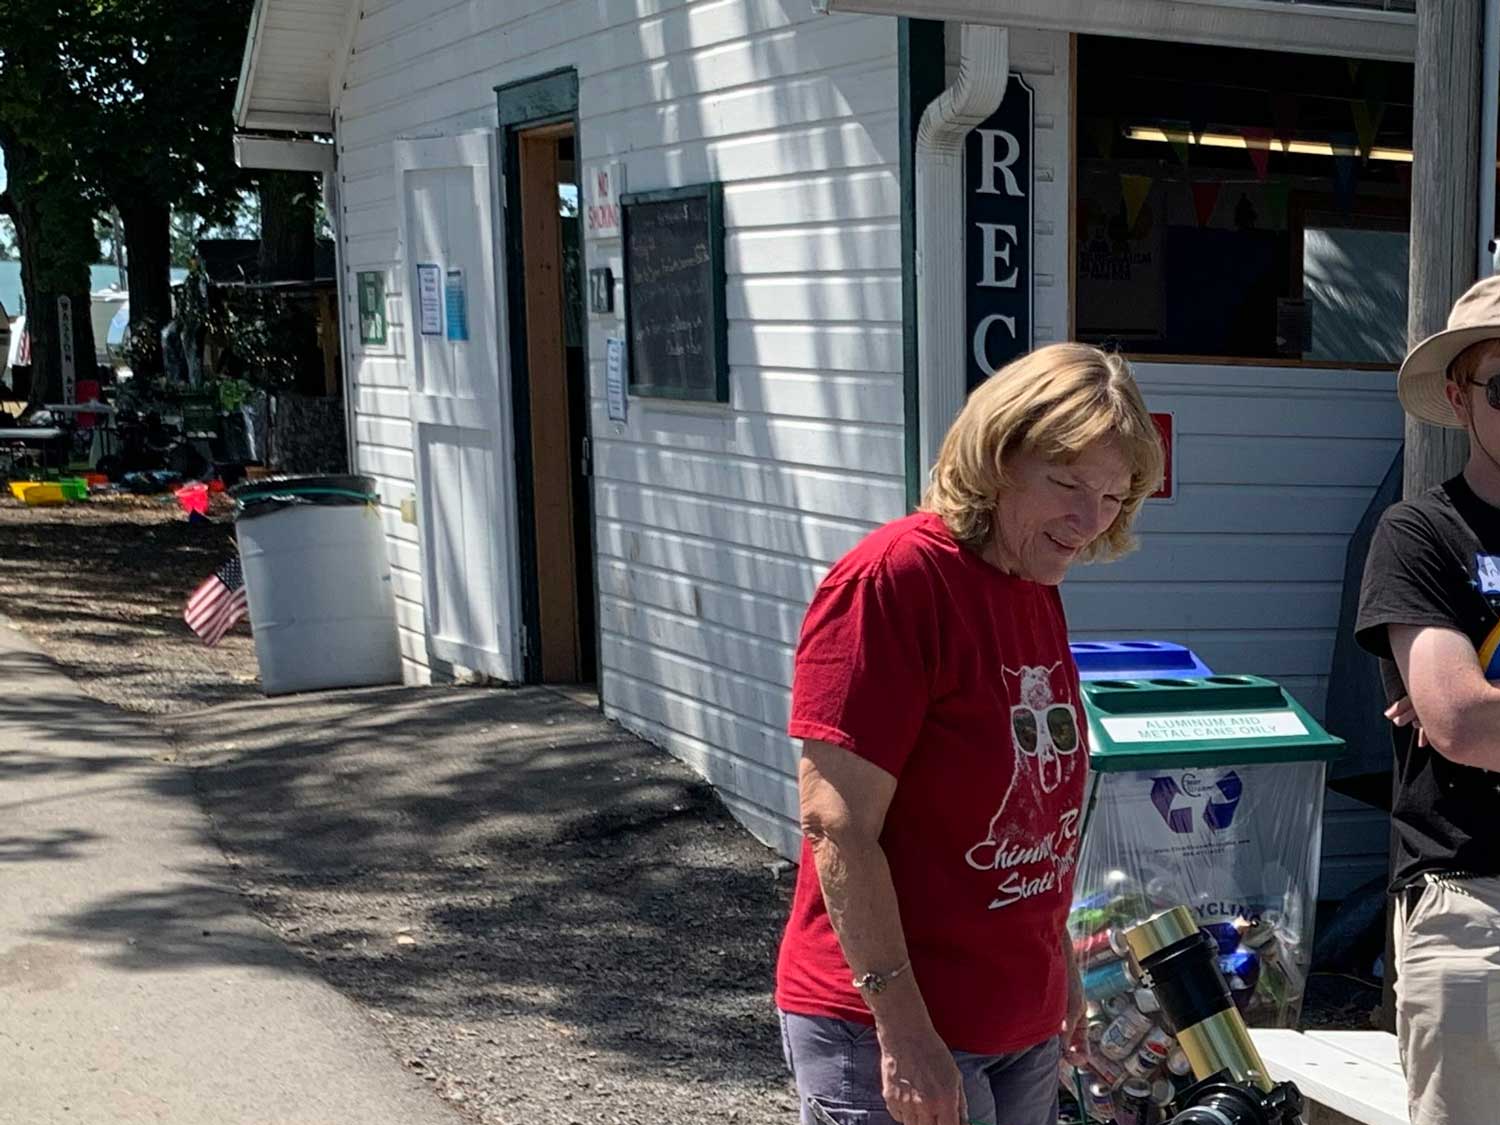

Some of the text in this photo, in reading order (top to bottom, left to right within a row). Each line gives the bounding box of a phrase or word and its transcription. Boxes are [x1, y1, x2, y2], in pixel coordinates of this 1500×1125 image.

[974, 128, 1026, 378] REC
[1146, 715, 1261, 729] ALUMINUM AND
[1138, 725, 1278, 739] METAL CANS ONLY
